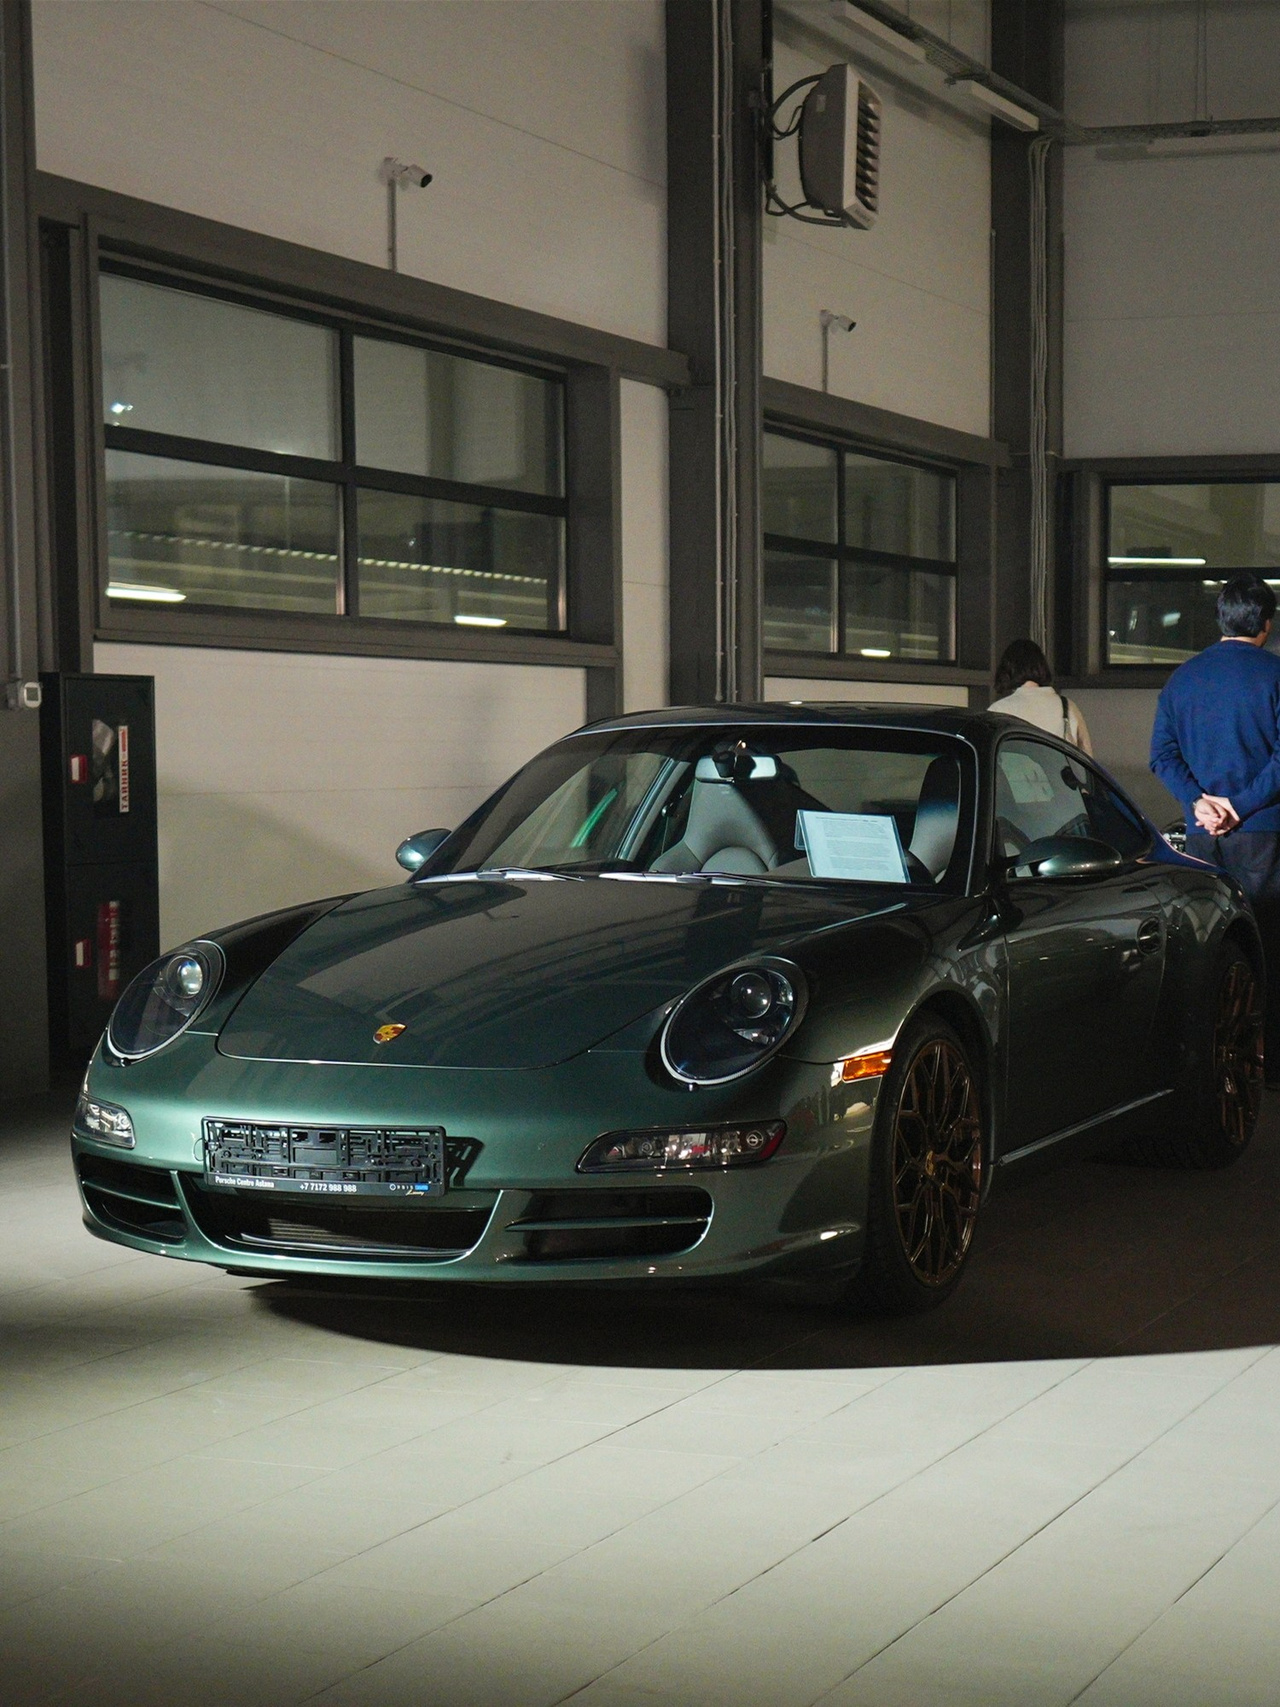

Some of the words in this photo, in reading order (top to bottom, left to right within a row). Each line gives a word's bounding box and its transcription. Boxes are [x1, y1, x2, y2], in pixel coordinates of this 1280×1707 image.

[214, 1176, 236, 1185] Porsche
[299, 1182, 309, 1191] +7
[310, 1183, 327, 1192] 7172
[328, 1184, 342, 1192] 988
